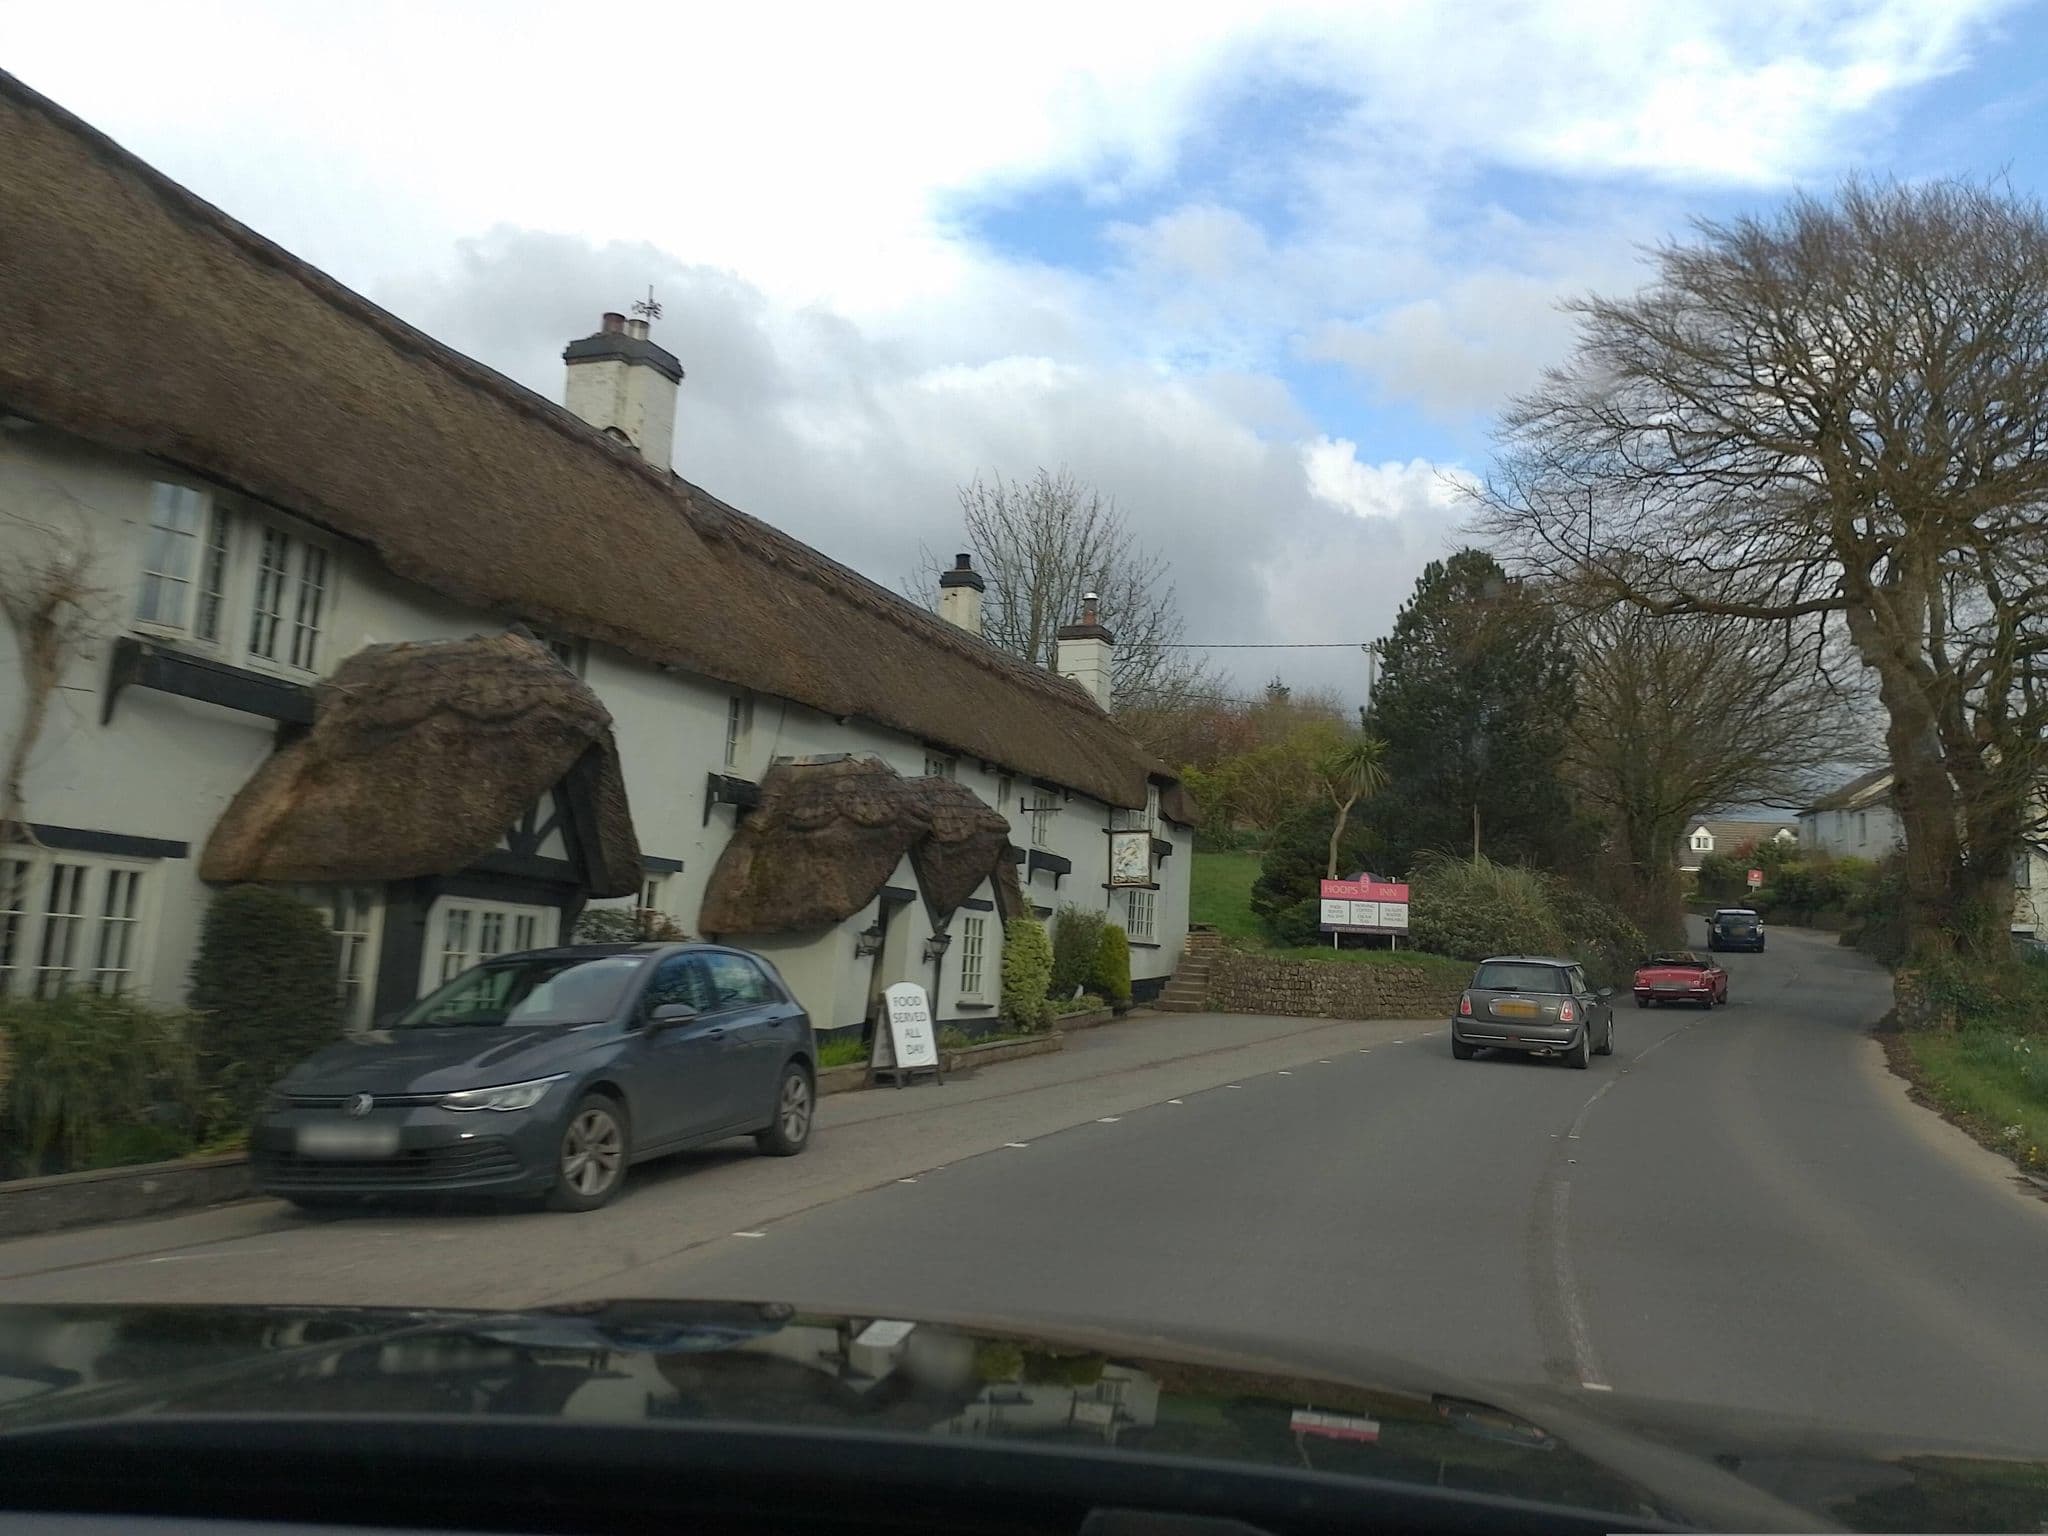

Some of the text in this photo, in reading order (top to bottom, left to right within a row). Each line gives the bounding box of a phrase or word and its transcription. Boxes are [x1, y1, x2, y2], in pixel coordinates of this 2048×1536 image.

[1324, 885, 1397, 897] HOOPS INN
[893, 996, 921, 1006] FOOD
[893, 1012, 927, 1023] SERVED
[905, 1028, 922, 1039] ALL
[906, 1044, 925, 1055] DAY
